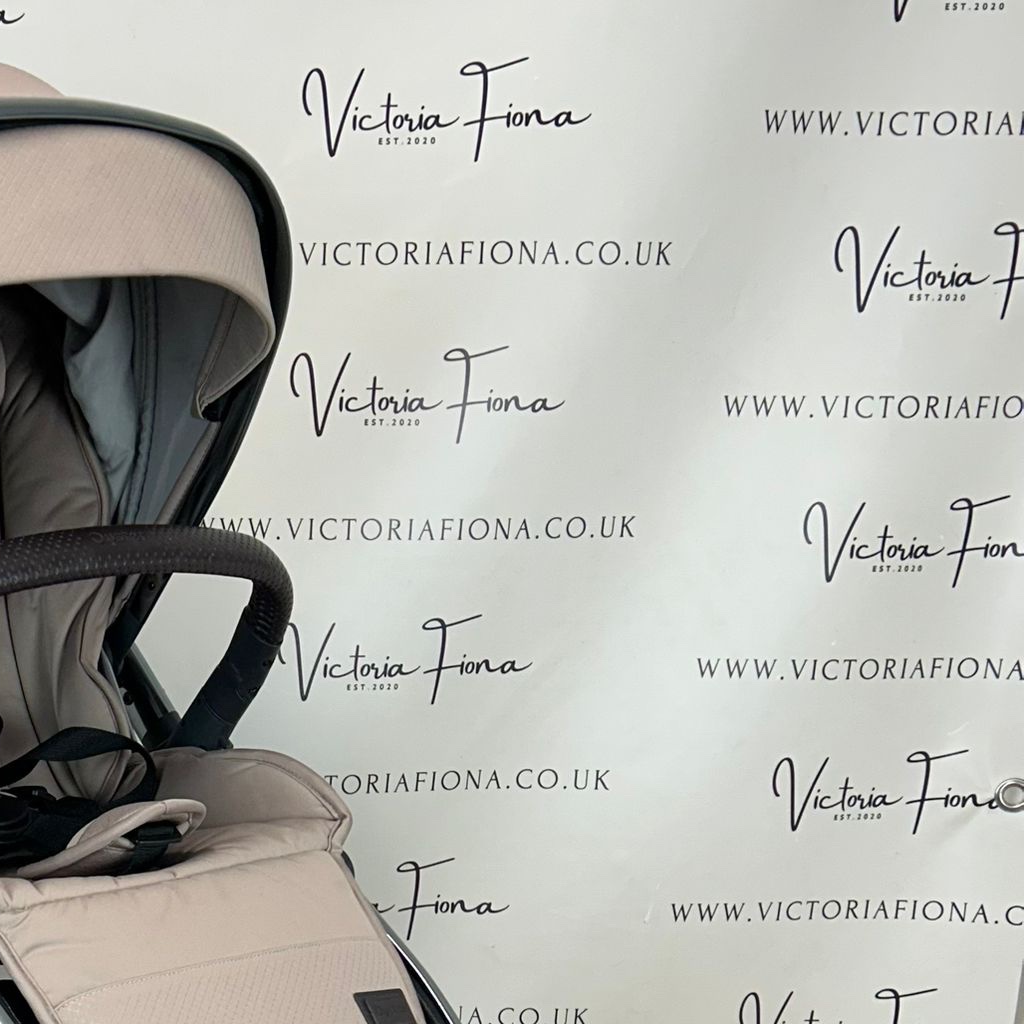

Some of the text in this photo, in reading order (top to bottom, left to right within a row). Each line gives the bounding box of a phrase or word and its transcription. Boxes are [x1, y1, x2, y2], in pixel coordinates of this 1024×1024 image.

[944, 2, 1005, 11] EST.2020
[302, 57, 592, 163] Victoria Fiona
[378, 137, 437, 146] EST.2020
[299, 240, 673, 267] VICTORIAFIONA.CO.UK
[834, 226, 991, 313] Victoria
[909, 293, 967, 302] EST.2020
[290, 346, 565, 444] Victoria Fiona
[364, 418, 421, 427] EST.2020
[803, 501, 945, 584] Victoria
[872, 565, 924, 573] EST.2020
[278, 614, 533, 705] Victoria Fiona
[697, 656, 1024, 682] WWW.VICTORIAFIONA
[347, 683, 399, 691] EST.2020
[772, 757, 904, 832] Victoria
[833, 813, 883, 822] EST.2020
[396, 857, 510, 941] Fiona
